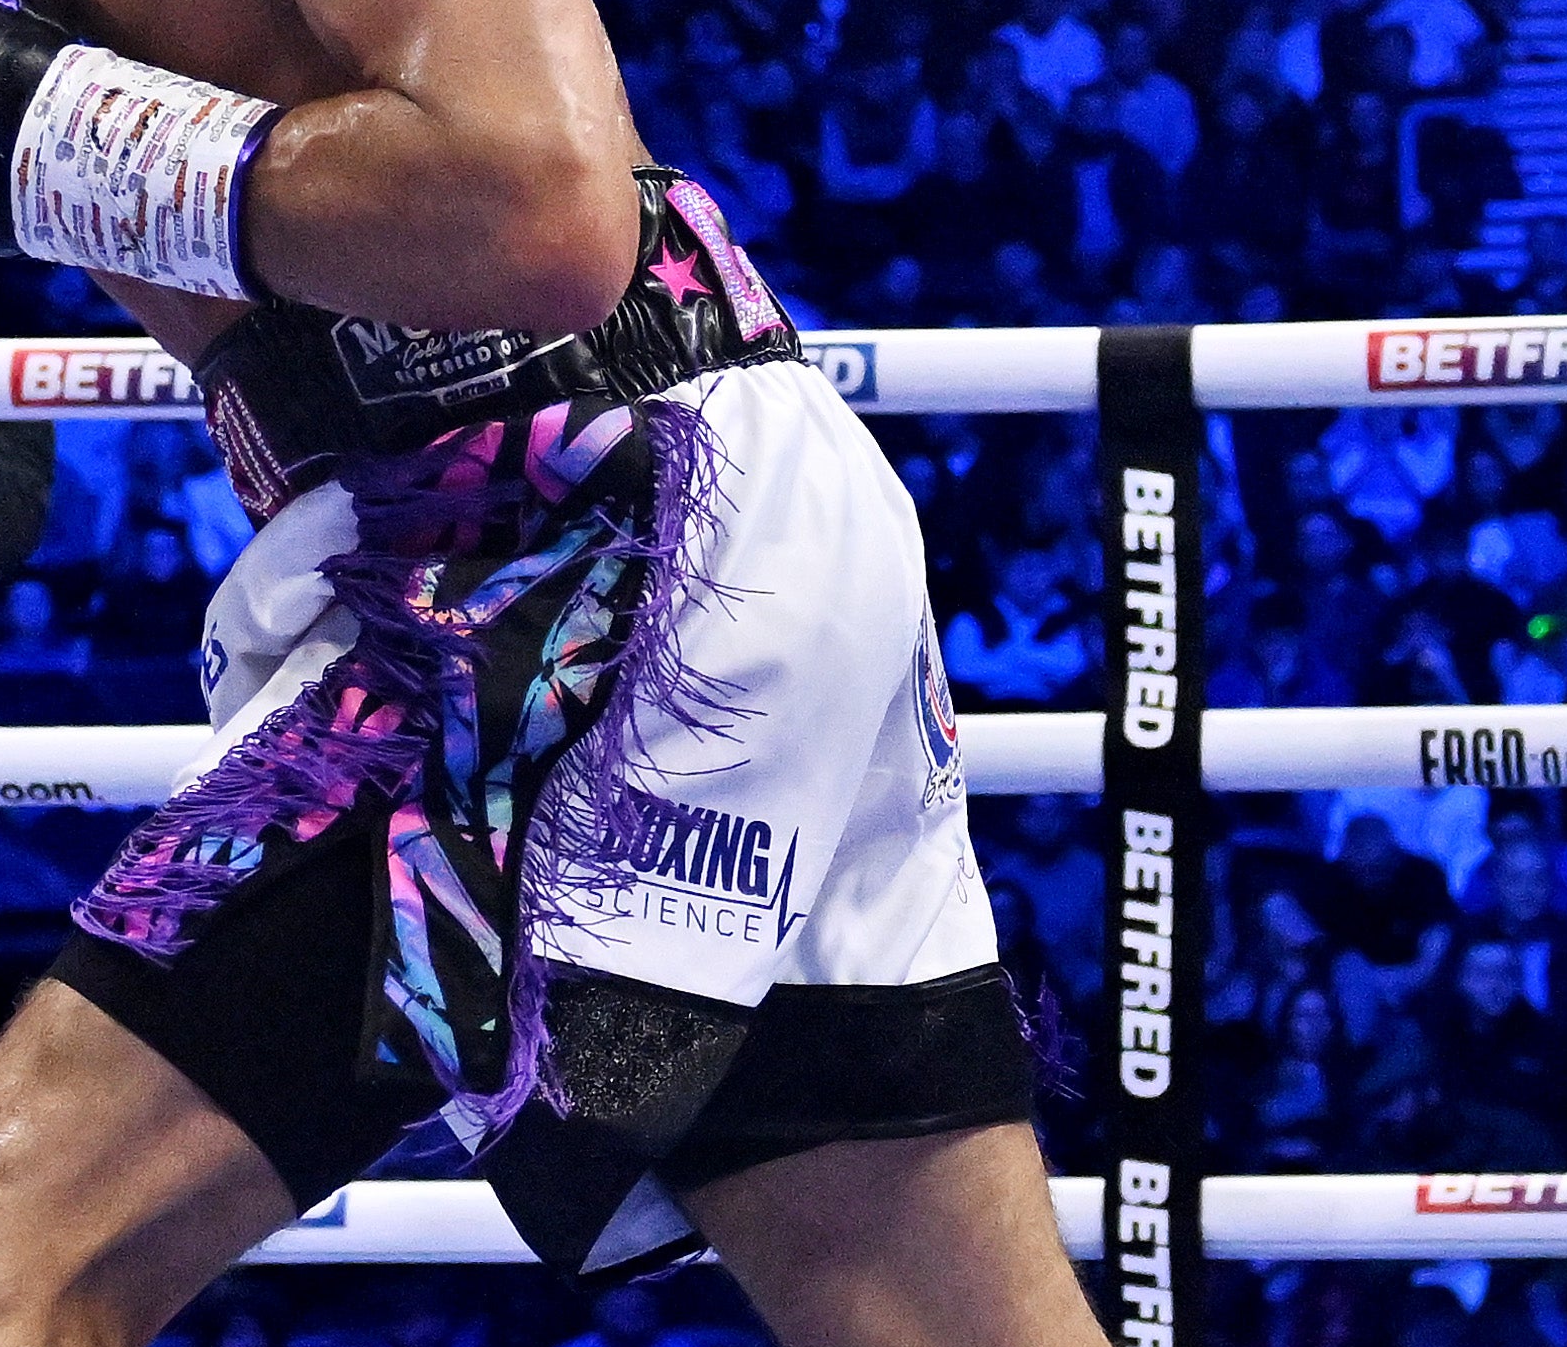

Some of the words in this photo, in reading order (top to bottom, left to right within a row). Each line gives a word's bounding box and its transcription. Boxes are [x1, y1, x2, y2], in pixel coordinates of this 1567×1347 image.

[1121, 466, 1179, 750] BETFRED
[585, 885, 764, 944] SCIENCE
[1119, 808, 1176, 1101] BETFRED
